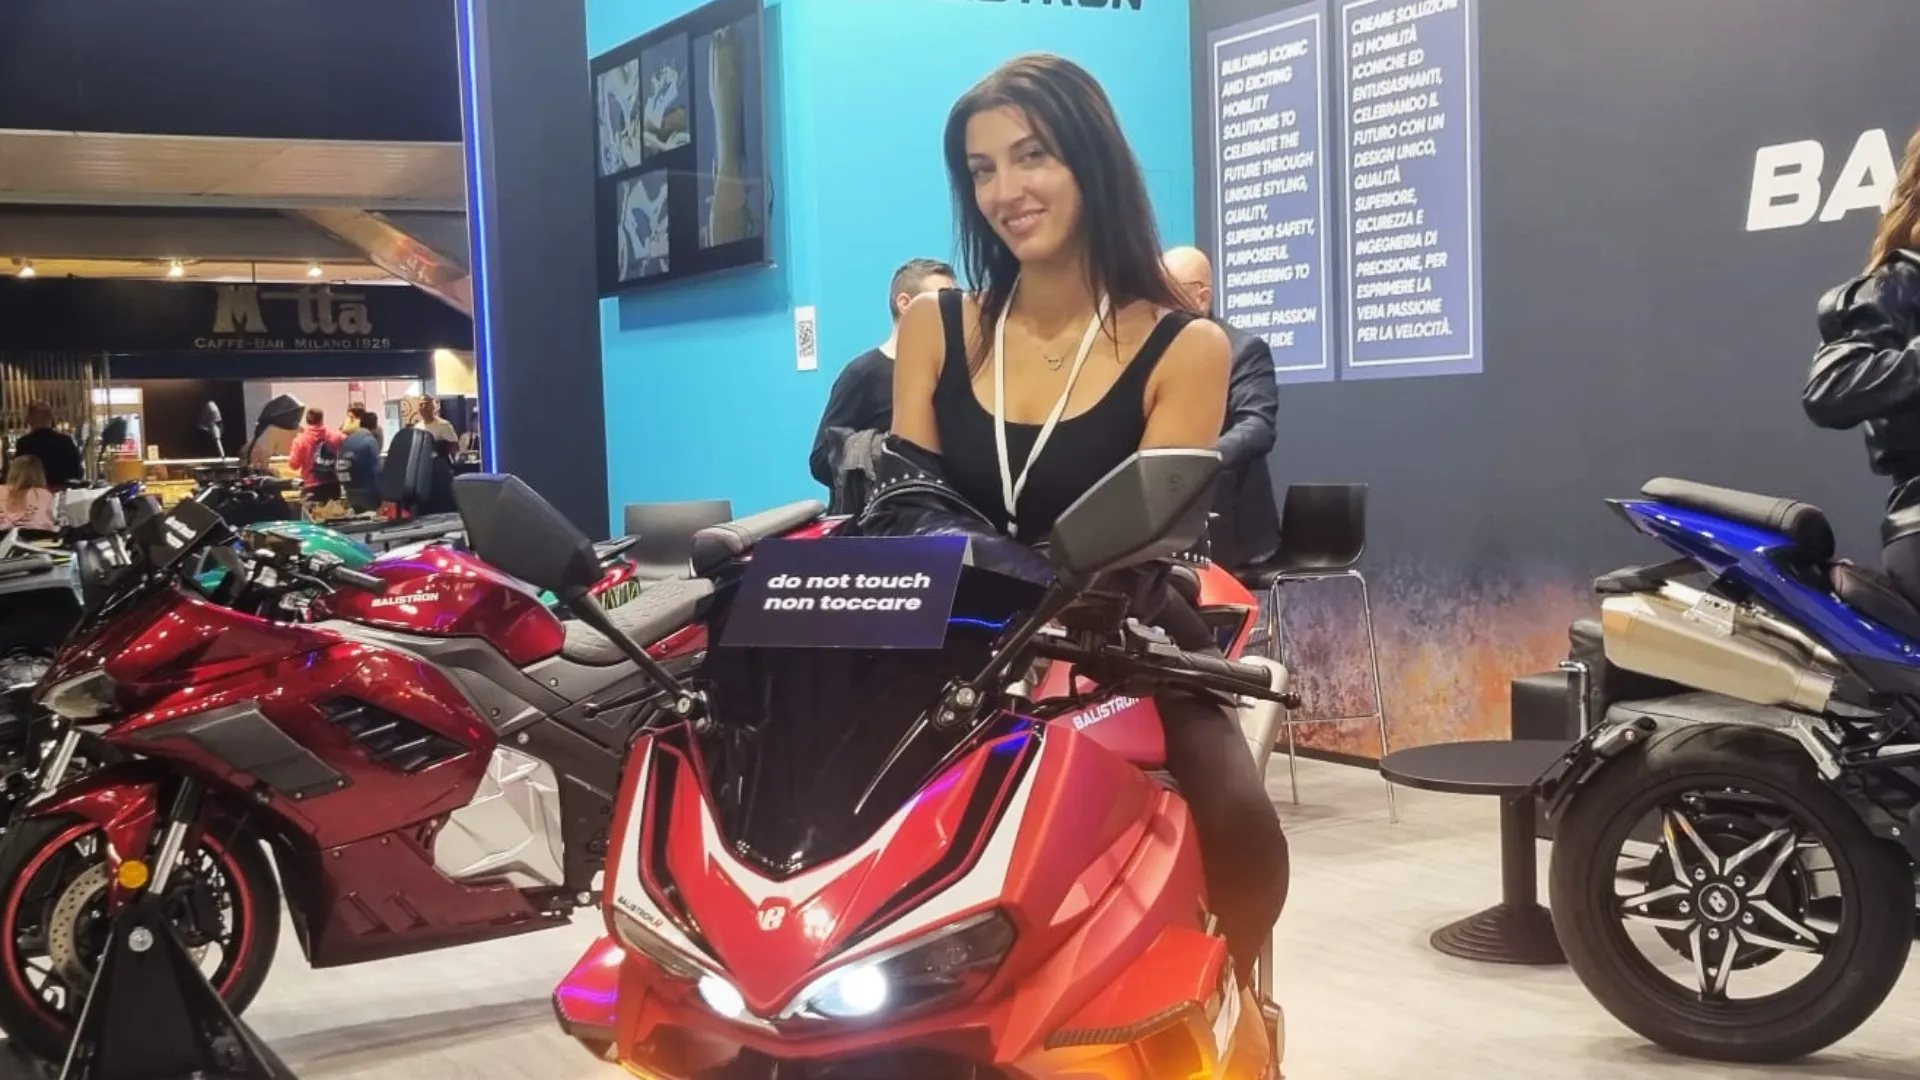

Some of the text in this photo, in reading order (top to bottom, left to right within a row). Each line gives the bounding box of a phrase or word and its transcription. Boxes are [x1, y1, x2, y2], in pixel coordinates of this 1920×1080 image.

[1352, 41, 1365, 59] DI
[1408, 48, 1424, 67] ED
[1353, 91, 1439, 124] CELEBRANDO IL
[1281, 110, 1296, 128] TO
[1353, 112, 1445, 146] FUTURO CON UN
[1354, 145, 1395, 168] DESIGN
[1224, 151, 1314, 183] FUTURE THROUGH
[1354, 164, 1400, 190] QUALITÀ
[1225, 183, 1262, 204] UNIQUE
[1355, 208, 1424, 234] SICUREZZA E
[1355, 229, 1438, 256] INGEGNERIA DI
[1425, 252, 1448, 269] PER
[1294, 263, 1309, 279] TO
[1356, 276, 1432, 300] ESPRIMERE LA
[1272, 306, 1317, 325] PASSION
[1357, 297, 1443, 321] VERA PASSIONE
[1357, 326, 1378, 343] PER
[1379, 324, 1394, 341] LA
[767, 572, 931, 590] do not touch
[371, 592, 439, 606] BALISTRON
[763, 594, 922, 611] non toccare
